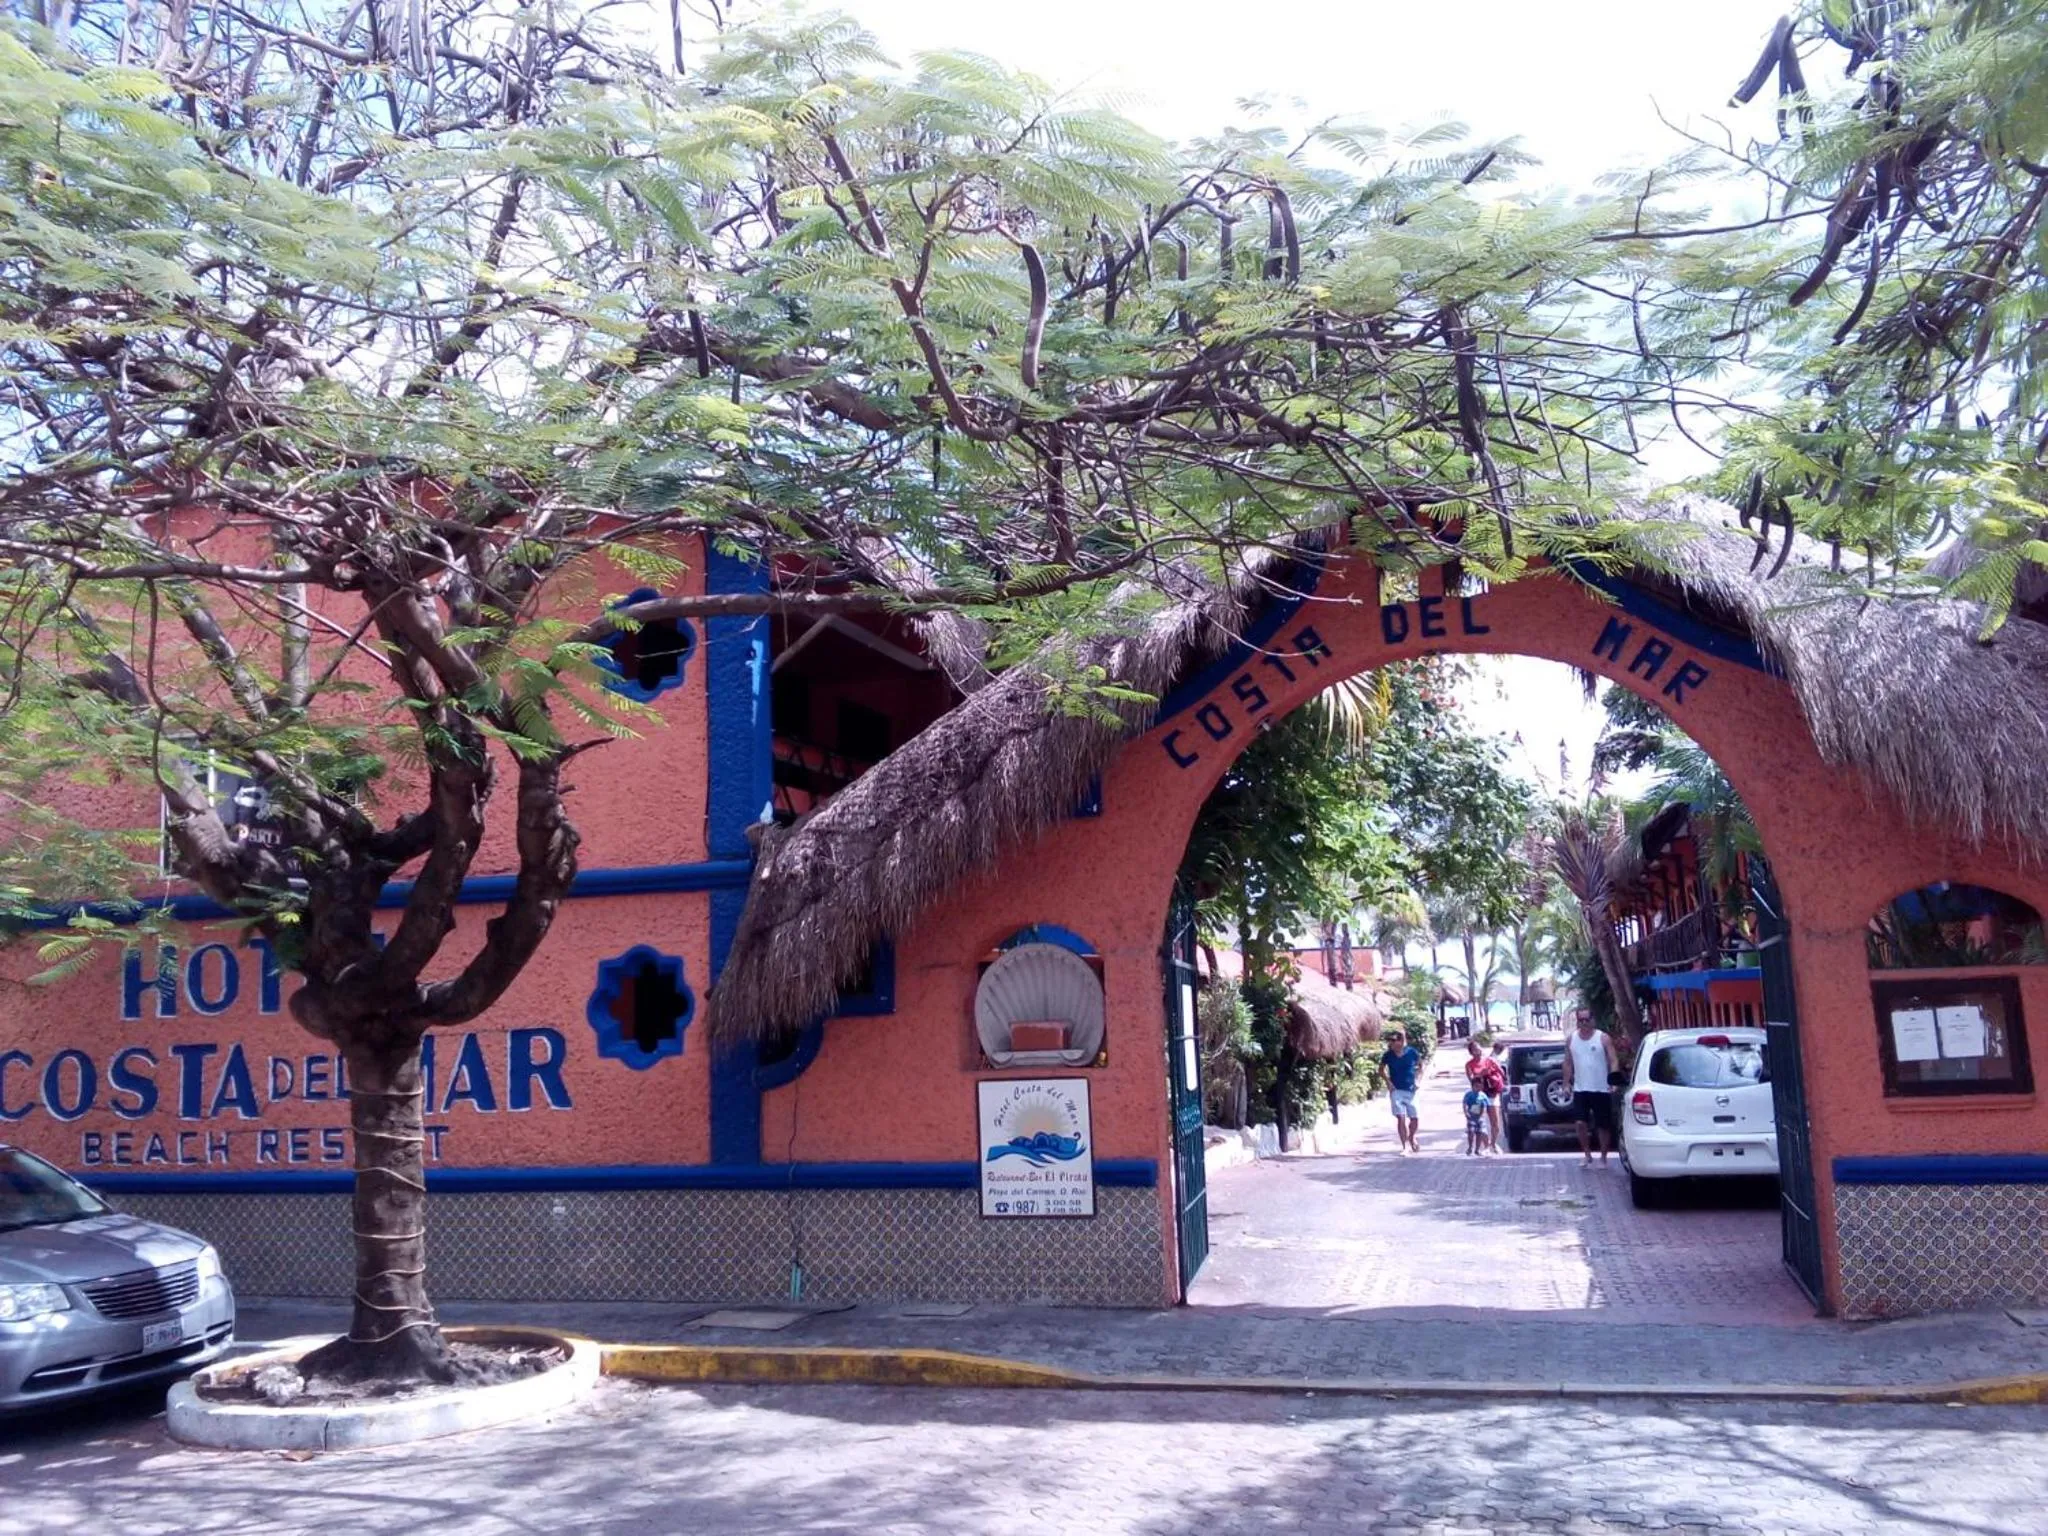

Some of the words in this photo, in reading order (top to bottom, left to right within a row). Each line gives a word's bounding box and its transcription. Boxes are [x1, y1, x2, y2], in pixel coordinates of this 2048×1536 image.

[1161, 625, 1333, 769] COSTA
[1380, 596, 1491, 645] DEL
[1590, 616, 1709, 705] MAR
[0, 1041, 261, 1122] COSTA
[268, 1054, 351, 1103] DEL
[81, 1130, 230, 1166] BEACH
[256, 1125, 450, 1165] REST
[1012, 1200, 1040, 1214] (987)
